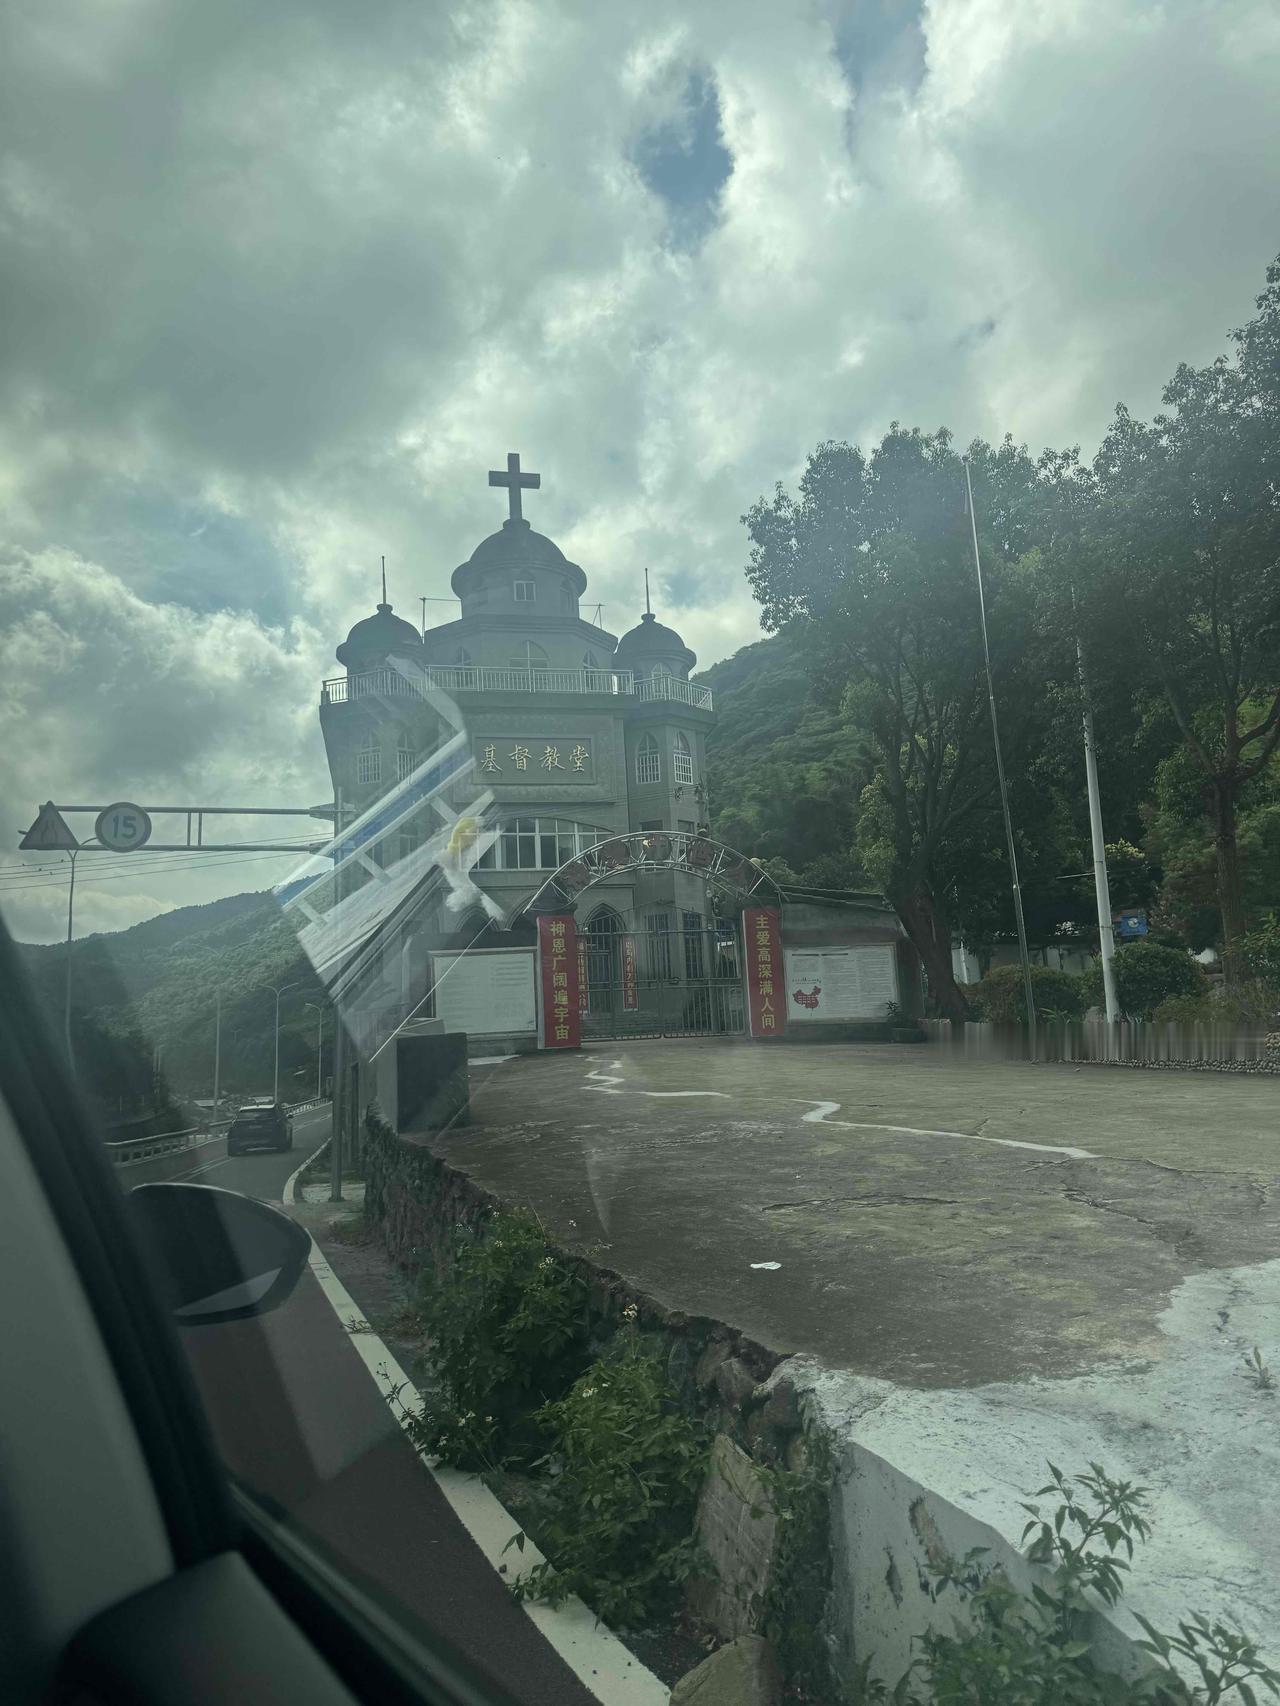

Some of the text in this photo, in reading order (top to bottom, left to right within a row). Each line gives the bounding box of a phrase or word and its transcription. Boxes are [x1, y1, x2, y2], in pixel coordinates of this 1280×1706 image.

[481, 744, 589, 772] 基督教堂
[113, 815, 137, 839] 15
[550, 921, 570, 1040] 神恩广阔遍宇宙
[755, 915, 775, 1029] 主爱高深满人间
